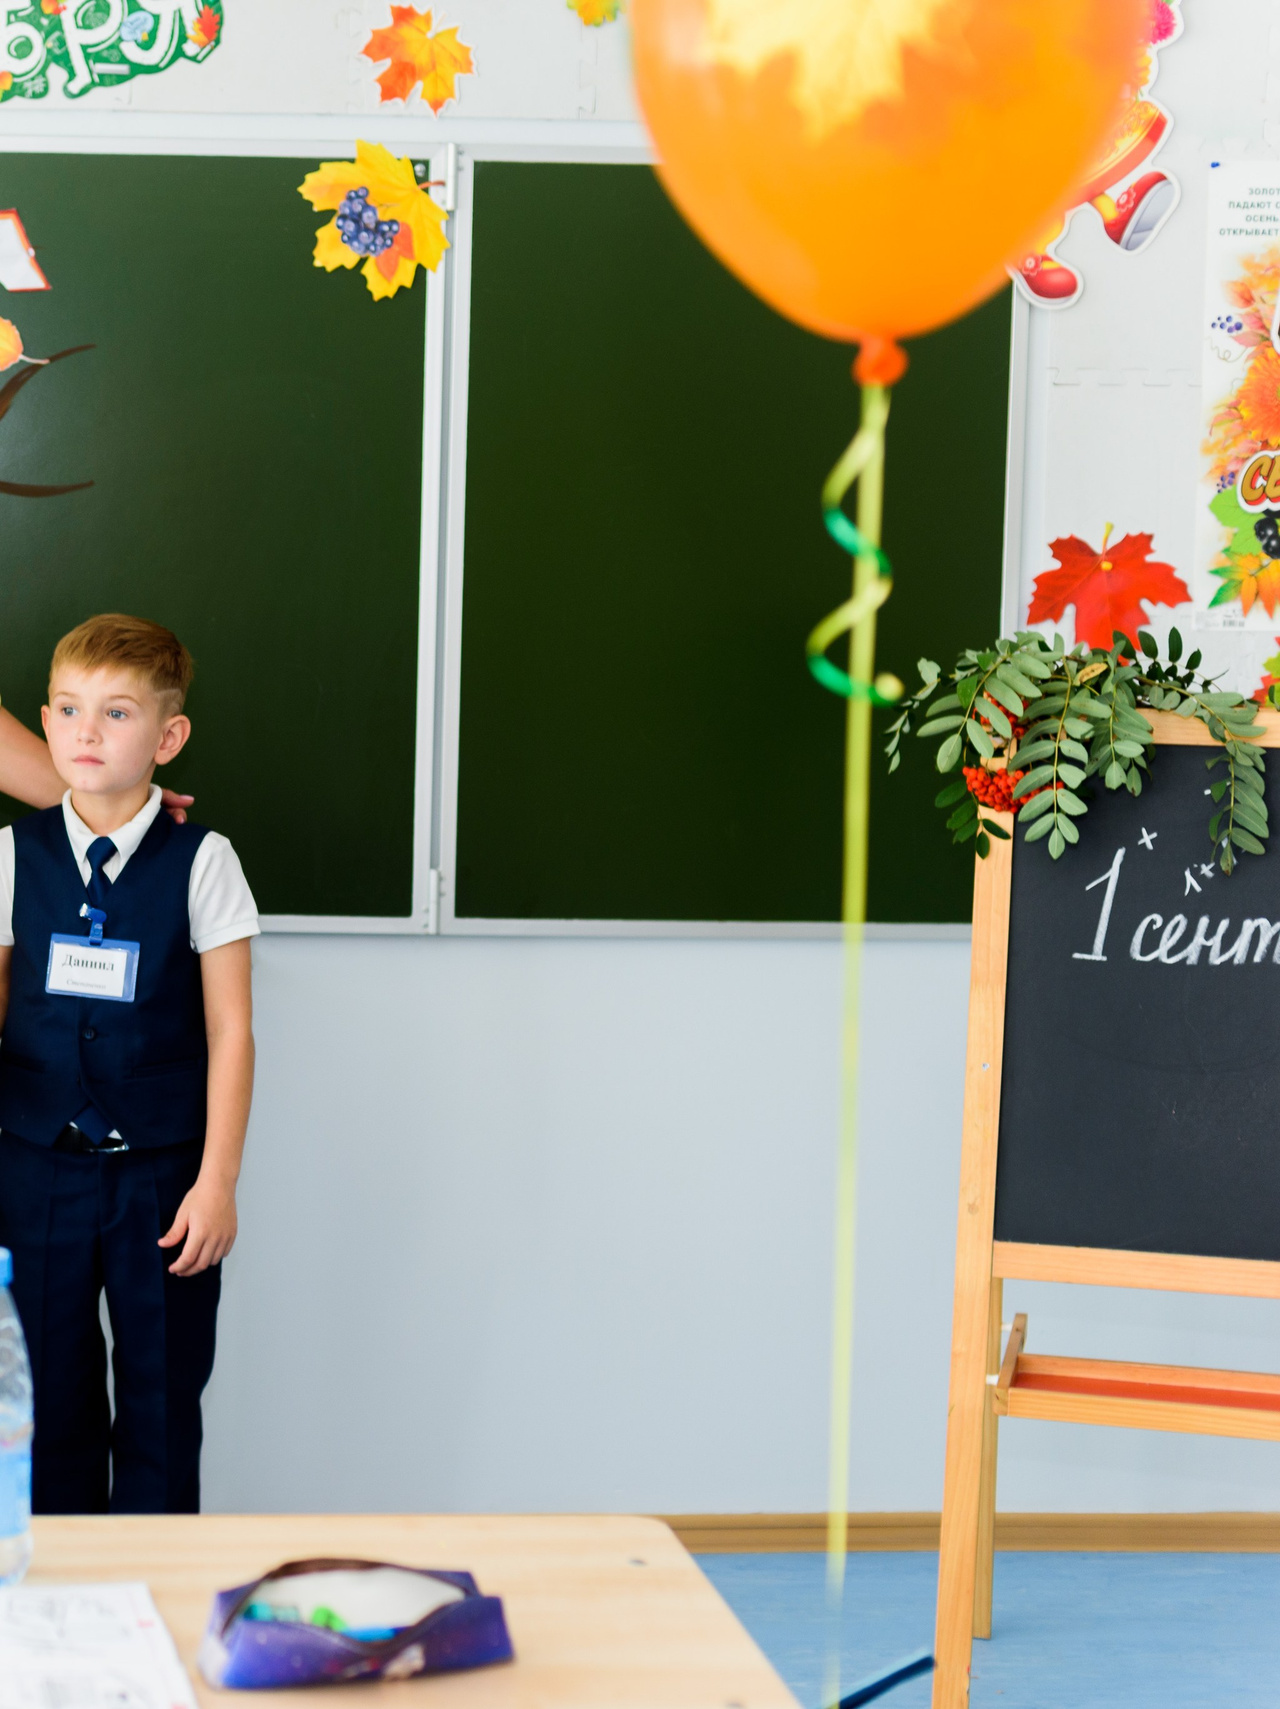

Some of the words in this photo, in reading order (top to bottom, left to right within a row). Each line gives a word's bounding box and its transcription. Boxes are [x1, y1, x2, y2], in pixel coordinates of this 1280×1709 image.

[1228, 201, 1272, 210] ПАДАЮТ
[1219, 227, 1279, 236] ОТКРЫВАЕТ
[1072, 846, 1126, 961] 1
